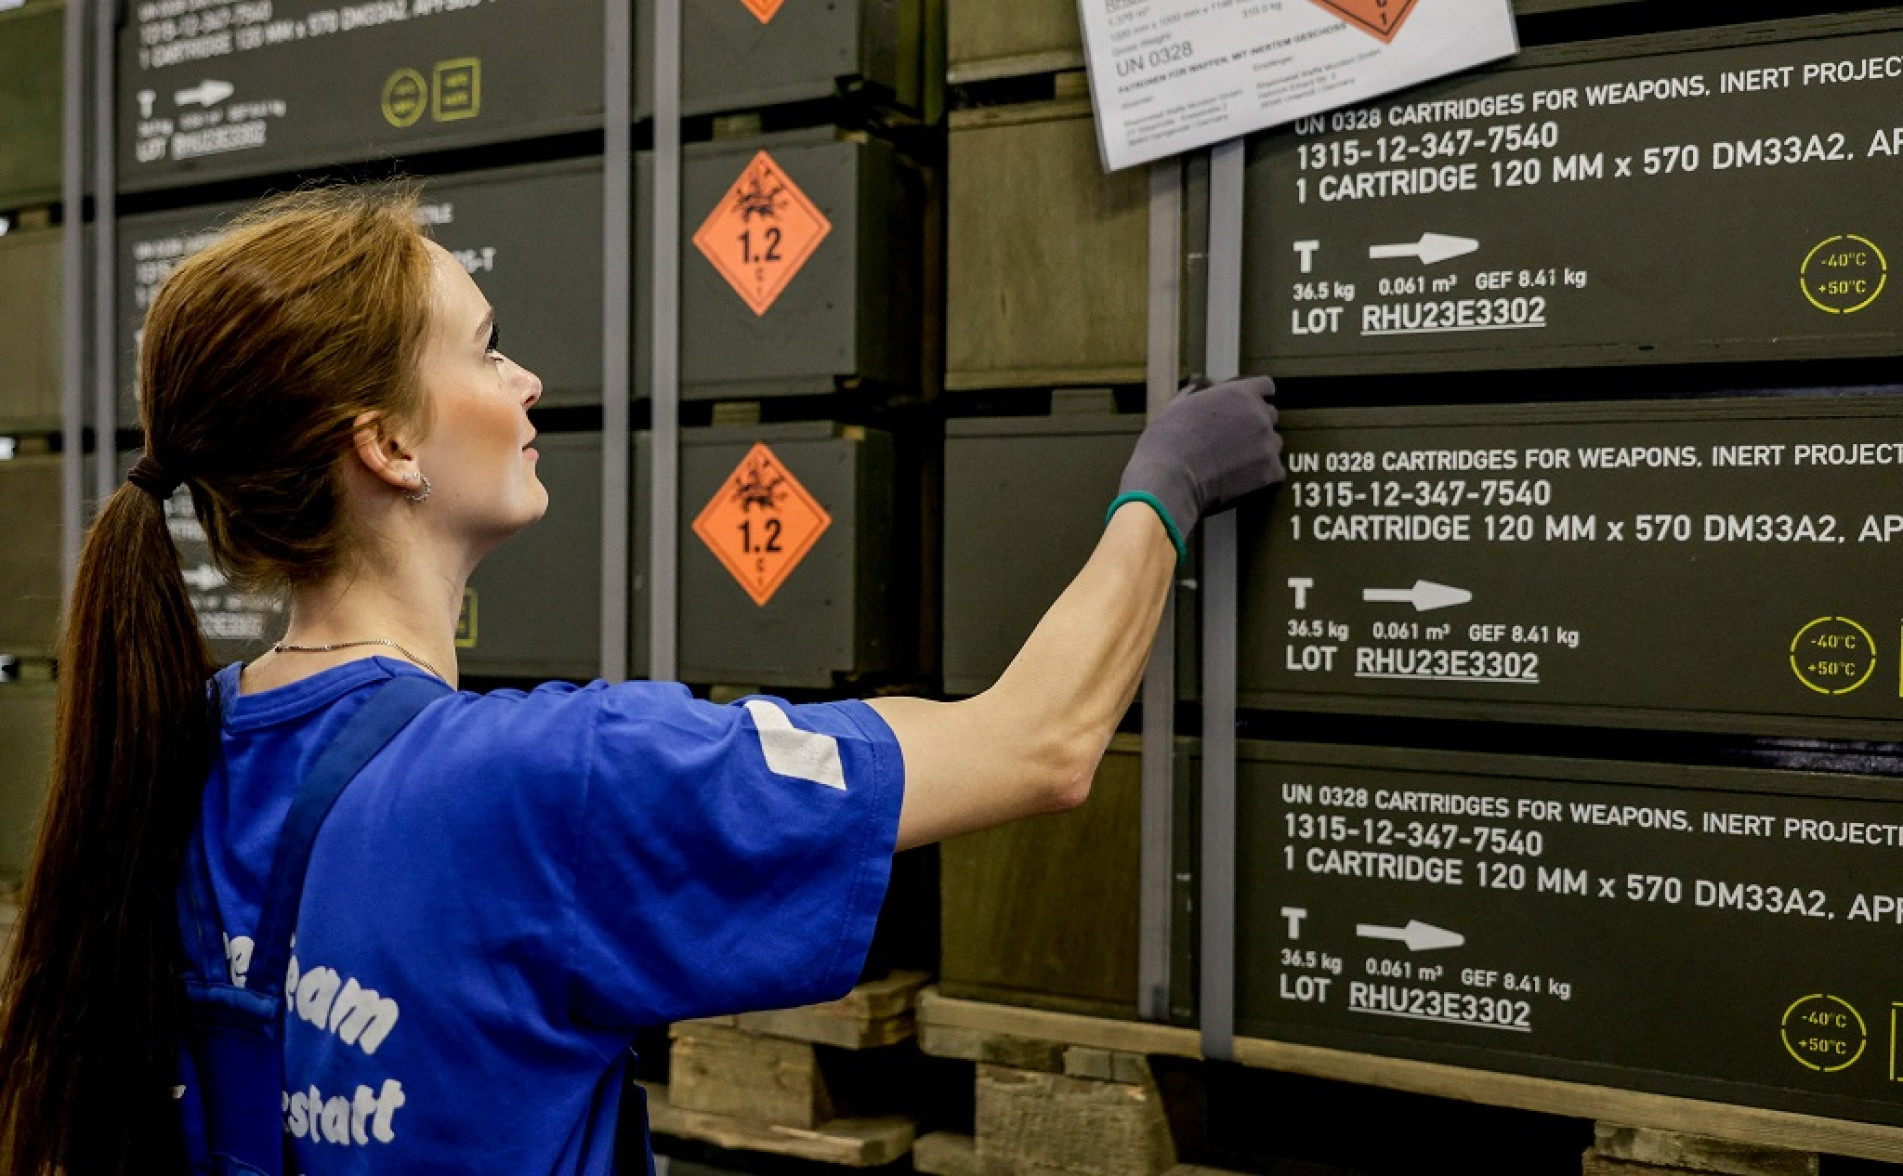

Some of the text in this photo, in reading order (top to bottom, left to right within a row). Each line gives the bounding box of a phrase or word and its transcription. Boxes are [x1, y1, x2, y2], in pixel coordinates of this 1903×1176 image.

[1116, 40, 1193, 77] UN 0328
[136, 89, 156, 119] T
[1295, 115, 1325, 135] UN
[1332, 109, 1381, 132] 0328
[1388, 94, 1525, 126] CARTRIDGES
[1533, 88, 1578, 112] FOR
[1720, 66, 1794, 94] INERT
[1802, 56, 1903, 86] PROJEC
[1297, 121, 1559, 170] 1315-12-347-7540
[1297, 178, 1307, 203] 1
[1319, 164, 1477, 202] CARTRIDGE
[1492, 160, 1541, 187] 120
[1552, 152, 1604, 182] MM
[1614, 156, 1632, 178] x
[1643, 145, 1700, 176] 570
[1712, 132, 1854, 170] DM33A2,
[738, 227, 781, 264] 1.2
[1293, 240, 1320, 273] T
[1820, 252, 1866, 268] -40°C
[1293, 268, 1587, 301] 36.5 kg 0.061 m³ GEF 8.41 kg
[1818, 280, 1866, 294] +50°C
[1292, 297, 1546, 335] LOT RHU23E3302
[1289, 452, 1319, 473] UN
[1326, 452, 1375, 472] 0328
[1382, 449, 1518, 471] CARTRIDGES
[1525, 448, 1570, 469] FOR
[1712, 444, 1785, 466] INERT
[1291, 479, 1551, 507] 1315-12-347-7540
[738, 518, 782, 553] 1.2
[1291, 515, 1300, 541] 1
[1313, 515, 1471, 541] CARTRIDGE
[1485, 515, 1534, 541] 120
[1545, 514, 1596, 541] MM
[1606, 521, 1624, 541] x
[1635, 514, 1692, 541] 570
[1704, 514, 1845, 543] DM33A2,
[1287, 577, 1314, 610] T
[1287, 620, 1580, 648] 36.5 kg 0.061 m³ GEF 8.41 kg
[1809, 634, 1856, 649] -40°C
[1286, 645, 1540, 681] LOT RHU23E3302
[1807, 660, 1856, 677] +50°C
[1282, 783, 1313, 804] UN
[1318, 786, 1368, 808] 0328
[1375, 789, 1510, 818] CARTRIDGES
[1517, 799, 1563, 822] FOR
[1702, 812, 1776, 837] INERT
[1285, 811, 1543, 857] 1315-12-347-7540
[1283, 845, 1295, 871] 1
[1306, 847, 1463, 885] CARTRIDGE
[1476, 861, 1526, 890] 120
[1537, 866, 1588, 896] MM
[1597, 876, 1616, 898] x
[1627, 873, 1682, 904] 570
[1694, 879, 1835, 920] DM33A2,
[1280, 907, 1307, 939] T
[1280, 949, 1572, 1000] 36.5 kg 0.061 m³ GEF 8.41 kg
[1279, 973, 1532, 1030] LOT RHU23E3302
[1801, 1011, 1847, 1029] -40°C
[1798, 1038, 1847, 1054] +50°C
